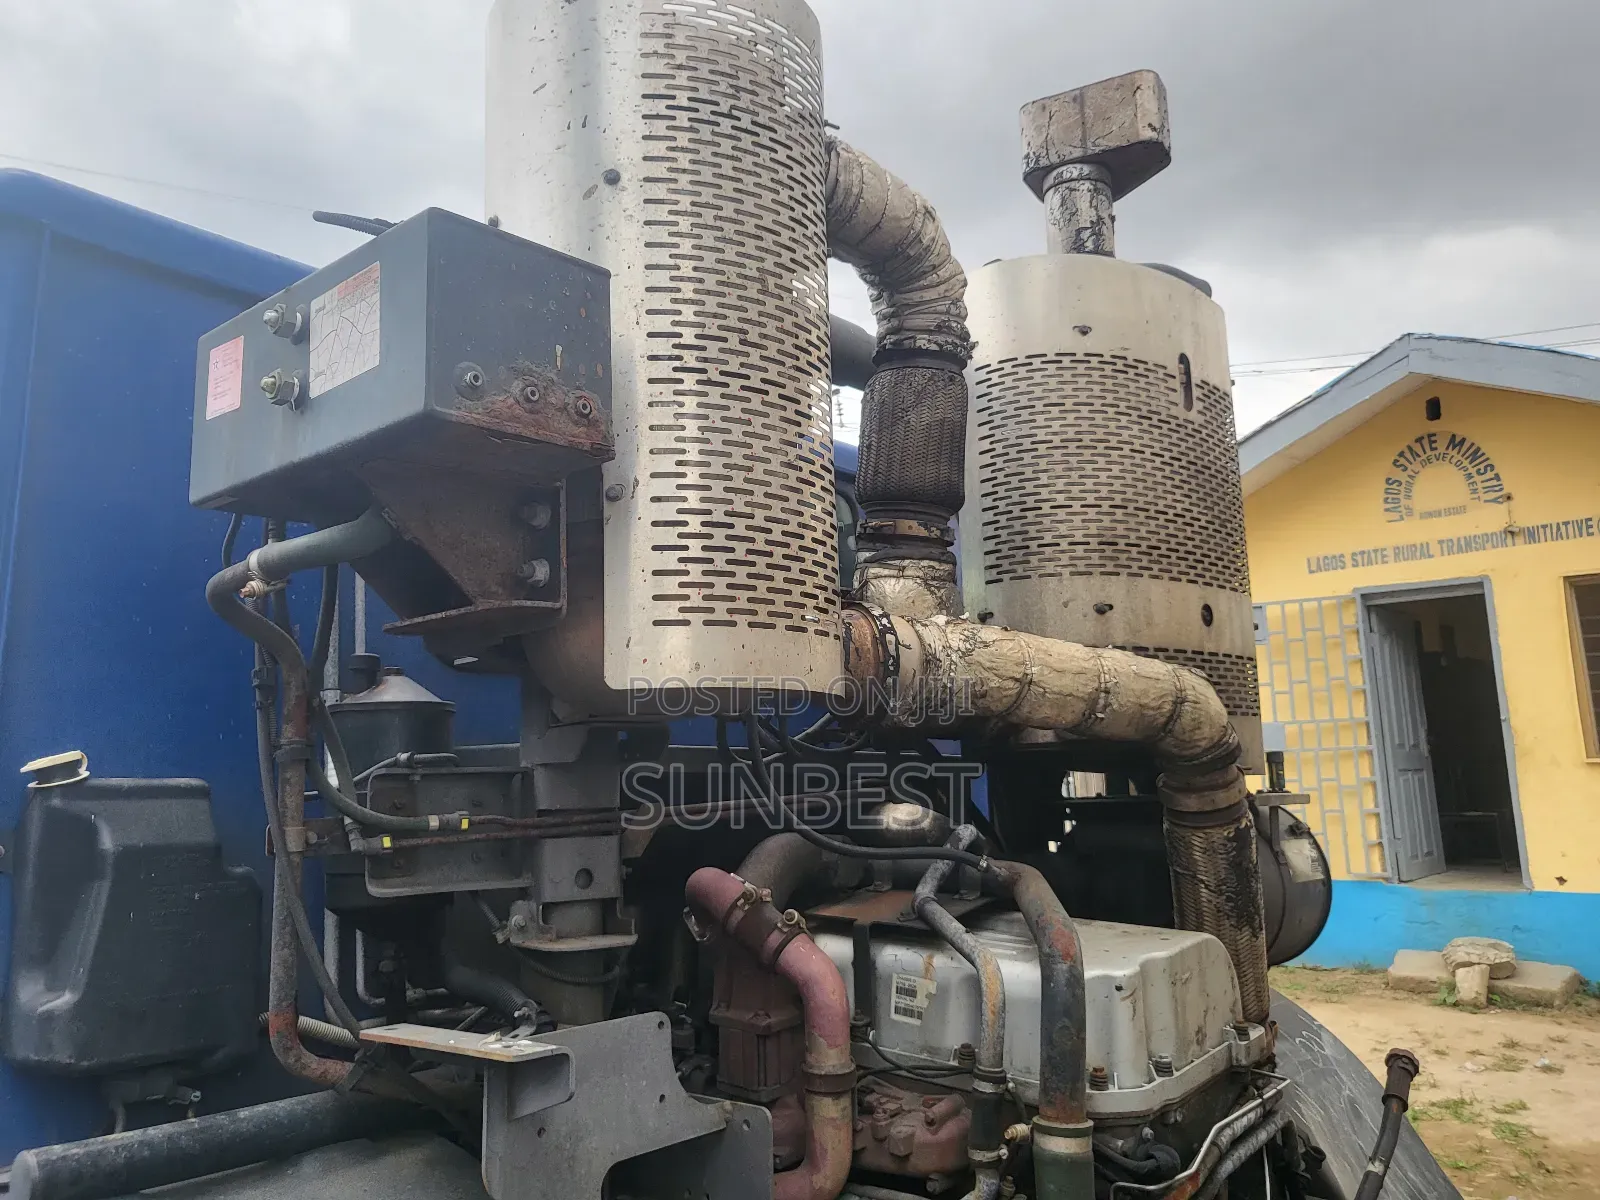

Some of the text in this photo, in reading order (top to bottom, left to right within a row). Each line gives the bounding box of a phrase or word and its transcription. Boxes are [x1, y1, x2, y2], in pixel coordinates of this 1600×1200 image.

[1383, 432, 1504, 523] LAGOS STATE MINISTRY
[1403, 467, 1420, 501] RURAL
[1419, 452, 1481, 502] DEVELOPMENT
[1307, 554, 1346, 575] LAGOS
[1350, 548, 1389, 568] STATE
[1393, 541, 1435, 564] RURAL
[1437, 528, 1516, 557] TRANSPORT
[1522, 517, 1595, 545] INITIATIVE
